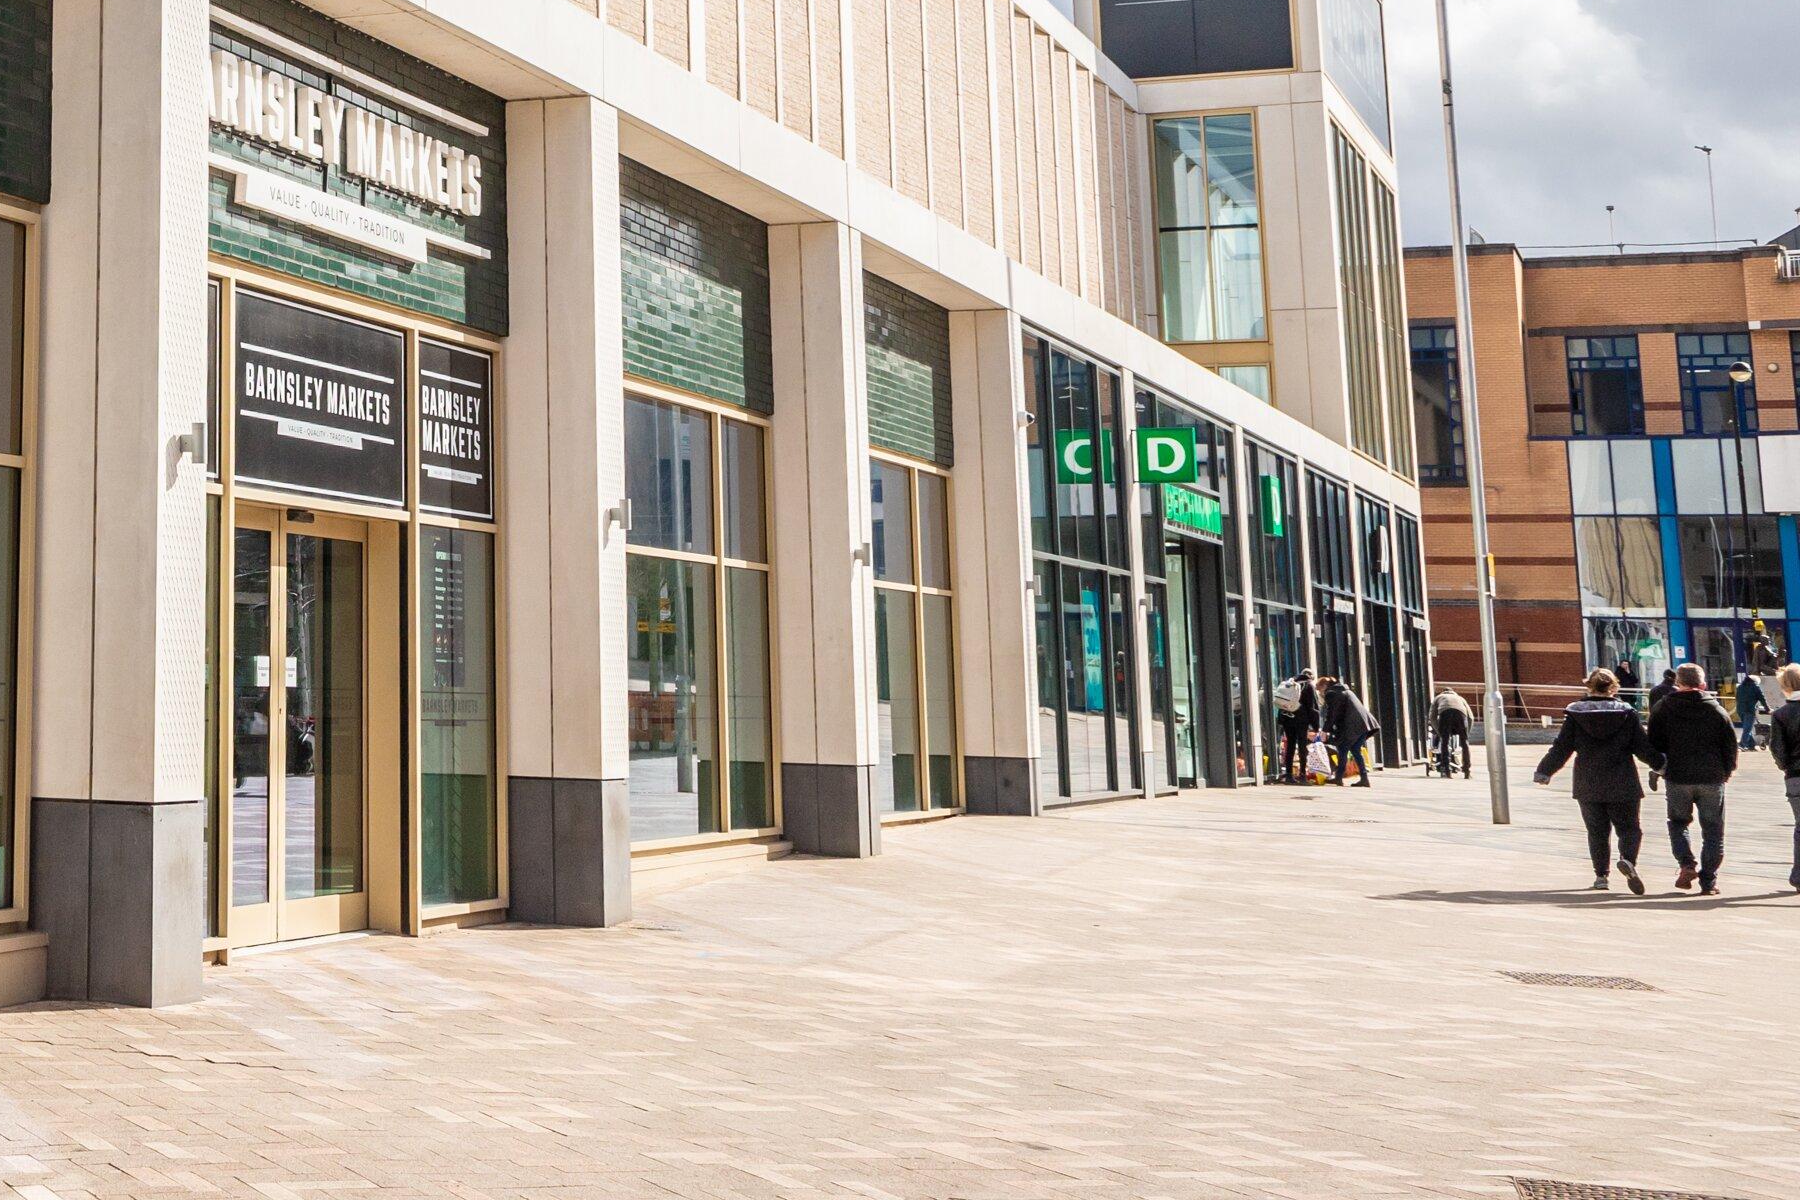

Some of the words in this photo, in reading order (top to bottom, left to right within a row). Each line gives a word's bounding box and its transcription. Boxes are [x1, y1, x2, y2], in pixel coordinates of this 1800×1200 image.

[348, 107, 482, 217] MARKETS
[269, 186, 301, 209] VALUE
[311, 200, 352, 225] QUALITY
[359, 217, 406, 245] TRADITION
[245, 362, 322, 411] BARNSLEY
[327, 381, 391, 426] MARKETS
[422, 385, 481, 425] BARNSLEY
[422, 420, 481, 461] MARKETS
[1147, 437, 1186, 474] D
